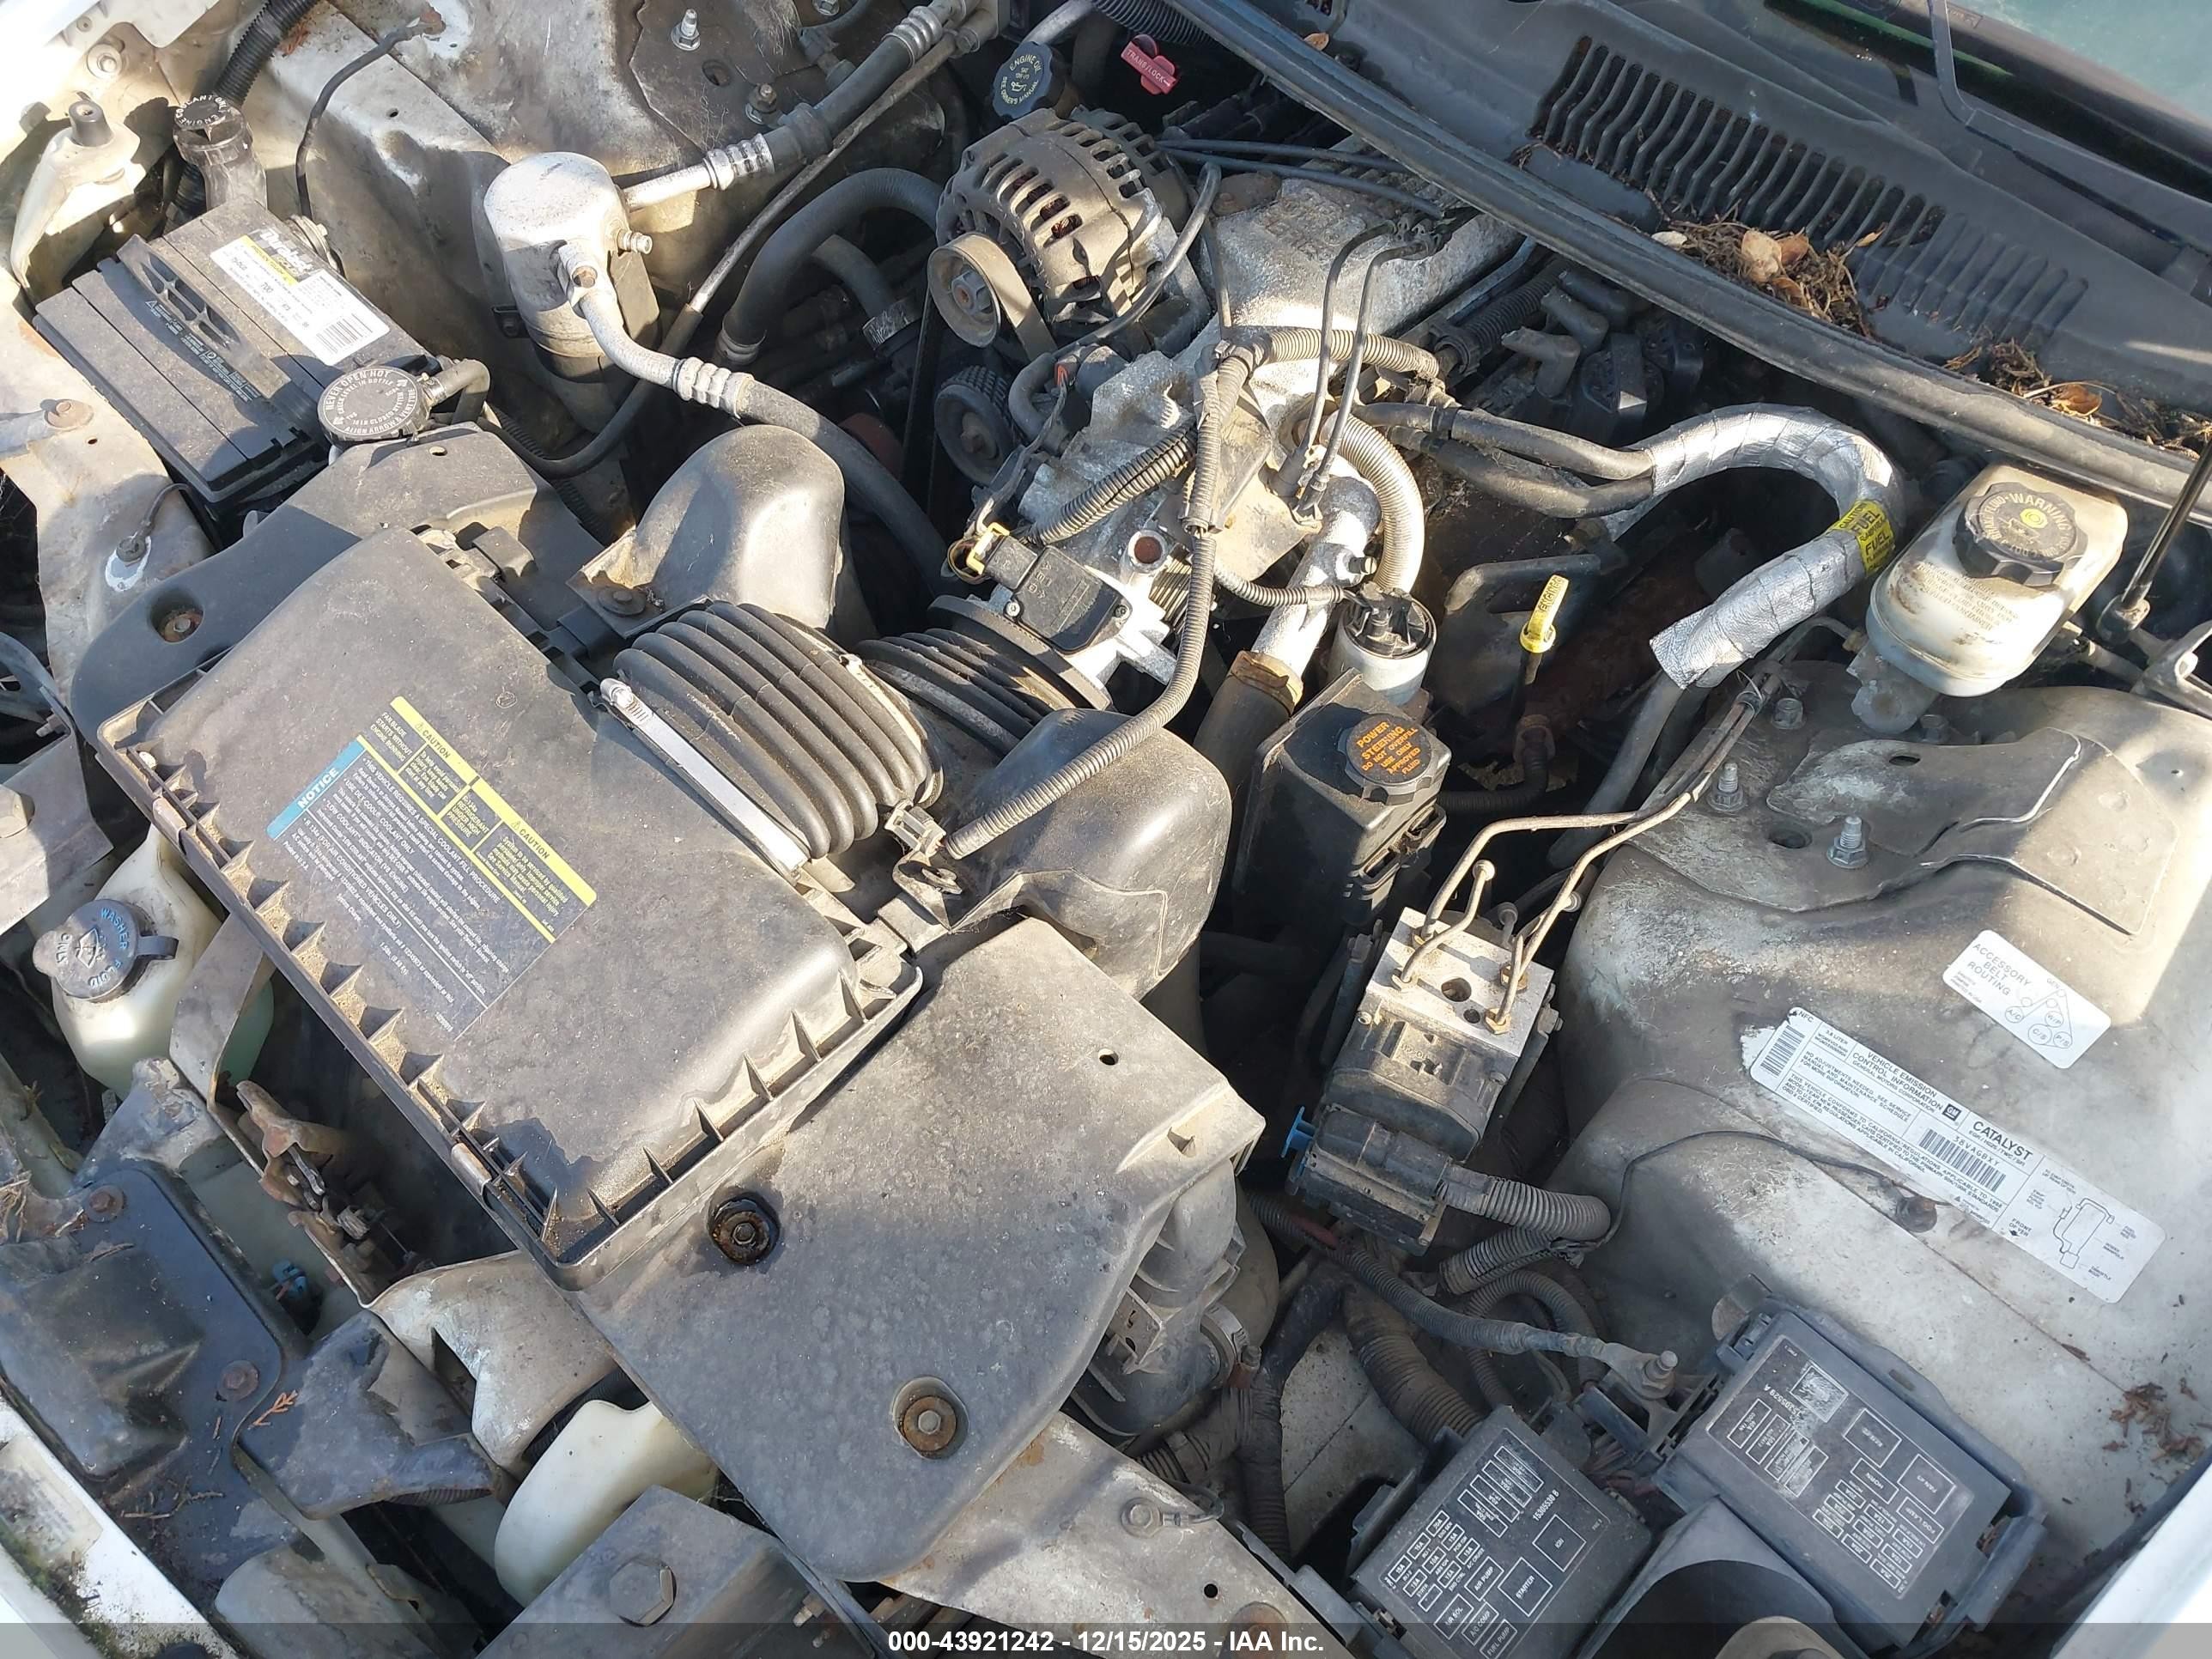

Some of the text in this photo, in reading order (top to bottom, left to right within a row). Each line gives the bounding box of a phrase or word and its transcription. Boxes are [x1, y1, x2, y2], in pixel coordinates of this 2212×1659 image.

[1010, 55, 1042, 74] ENGINE OIL
[175, 94, 214, 118] COOLANT
[325, 386, 343, 410] NEVER
[343, 372, 368, 386] OPEN
[1851, 510, 1881, 532] FUEL
[2009, 492, 2073, 531] WARNING
[1865, 531, 1889, 556] FUEL
[374, 716, 413, 757] STARTS WITHOUT
[380, 710, 408, 738] FAN BLADE
[1357, 721, 1389, 748] POWER
[368, 723, 407, 763] ENGINE RUNNING
[421, 728, 451, 759] CAUTION
[1361, 726, 1405, 760] STEERING
[1361, 727, 1419, 771] DO NOT OVERFILL
[1380, 741, 1412, 768] USE ONLY
[363, 758, 378, 774] THIS
[1387, 747, 1421, 775] APPROVED
[1401, 759, 1420, 775] FLUID
[295, 766, 341, 811] NOTICE
[373, 769, 396, 793] VEHICLE
[391, 788, 417, 817] REQUIRES
[343, 779, 357, 793] USE
[378, 816, 404, 843] COOLANT
[398, 838, 416, 856] ONLY
[413, 812, 422, 821] A
[416, 816, 440, 840] SPECIAL
[445, 809, 473, 838] PRESSURE
[450, 805, 481, 836] UNDER HIGH
[455, 799, 489, 835] REFRIGERANT
[356, 836, 385, 866] INDICATOR
[435, 836, 462, 863] COOLANT
[501, 835, 520, 854] System
[517, 827, 550, 860] CAUTION
[458, 859, 471, 873] FILL
[485, 851, 498, 863] See
[494, 859, 513, 878] Service
[327, 845, 339, 858] AIR
[335, 854, 368, 890] CONDITIONED
[363, 885, 389, 914] VEHICLES
[468, 869, 501, 904] PROCEDURE
[100, 908, 129, 949] WASHER
[1966, 959, 2012, 997] ROUTING
[1971, 941, 2033, 989] ACCESSORY
[1982, 960, 2008, 982] BELT
[1797, 1010, 1814, 1024] NFC
[2004, 1006, 2022, 1022] A/C
[1850, 1051, 1944, 1111] CONTROL INFORMATION
[1865, 1051, 1937, 1098] VEHICLE EMISSION
[1802, 1081, 1826, 1098] VEHICLE
[1857, 1115, 1867, 1124] TO
[1947, 1105, 1959, 1116] GM
[1971, 1119, 2033, 1163] CATALYST
[2010, 1217, 2033, 1233] FRONT
[1863, 1470, 1885, 1490] HORN
[1530, 1488, 1561, 1522] 15305530 B
[1447, 1531, 1458, 1543] 15A
[1920, 1519, 1937, 1534] FOG
[1462, 1545, 1474, 1557] 15A
[1553, 1536, 1565, 1549] IGN
[1395, 1563, 1406, 1575] 15A
[1473, 1565, 1496, 1591] AIR PUMP
[1409, 1577, 1421, 1589] 15A
[1513, 1574, 1536, 1599] STARTER
[1450, 1604, 1464, 1619] SOL
[1475, 1609, 1492, 1628] COMP
[1486, 1626, 1511, 1656] FUEL PUMP
